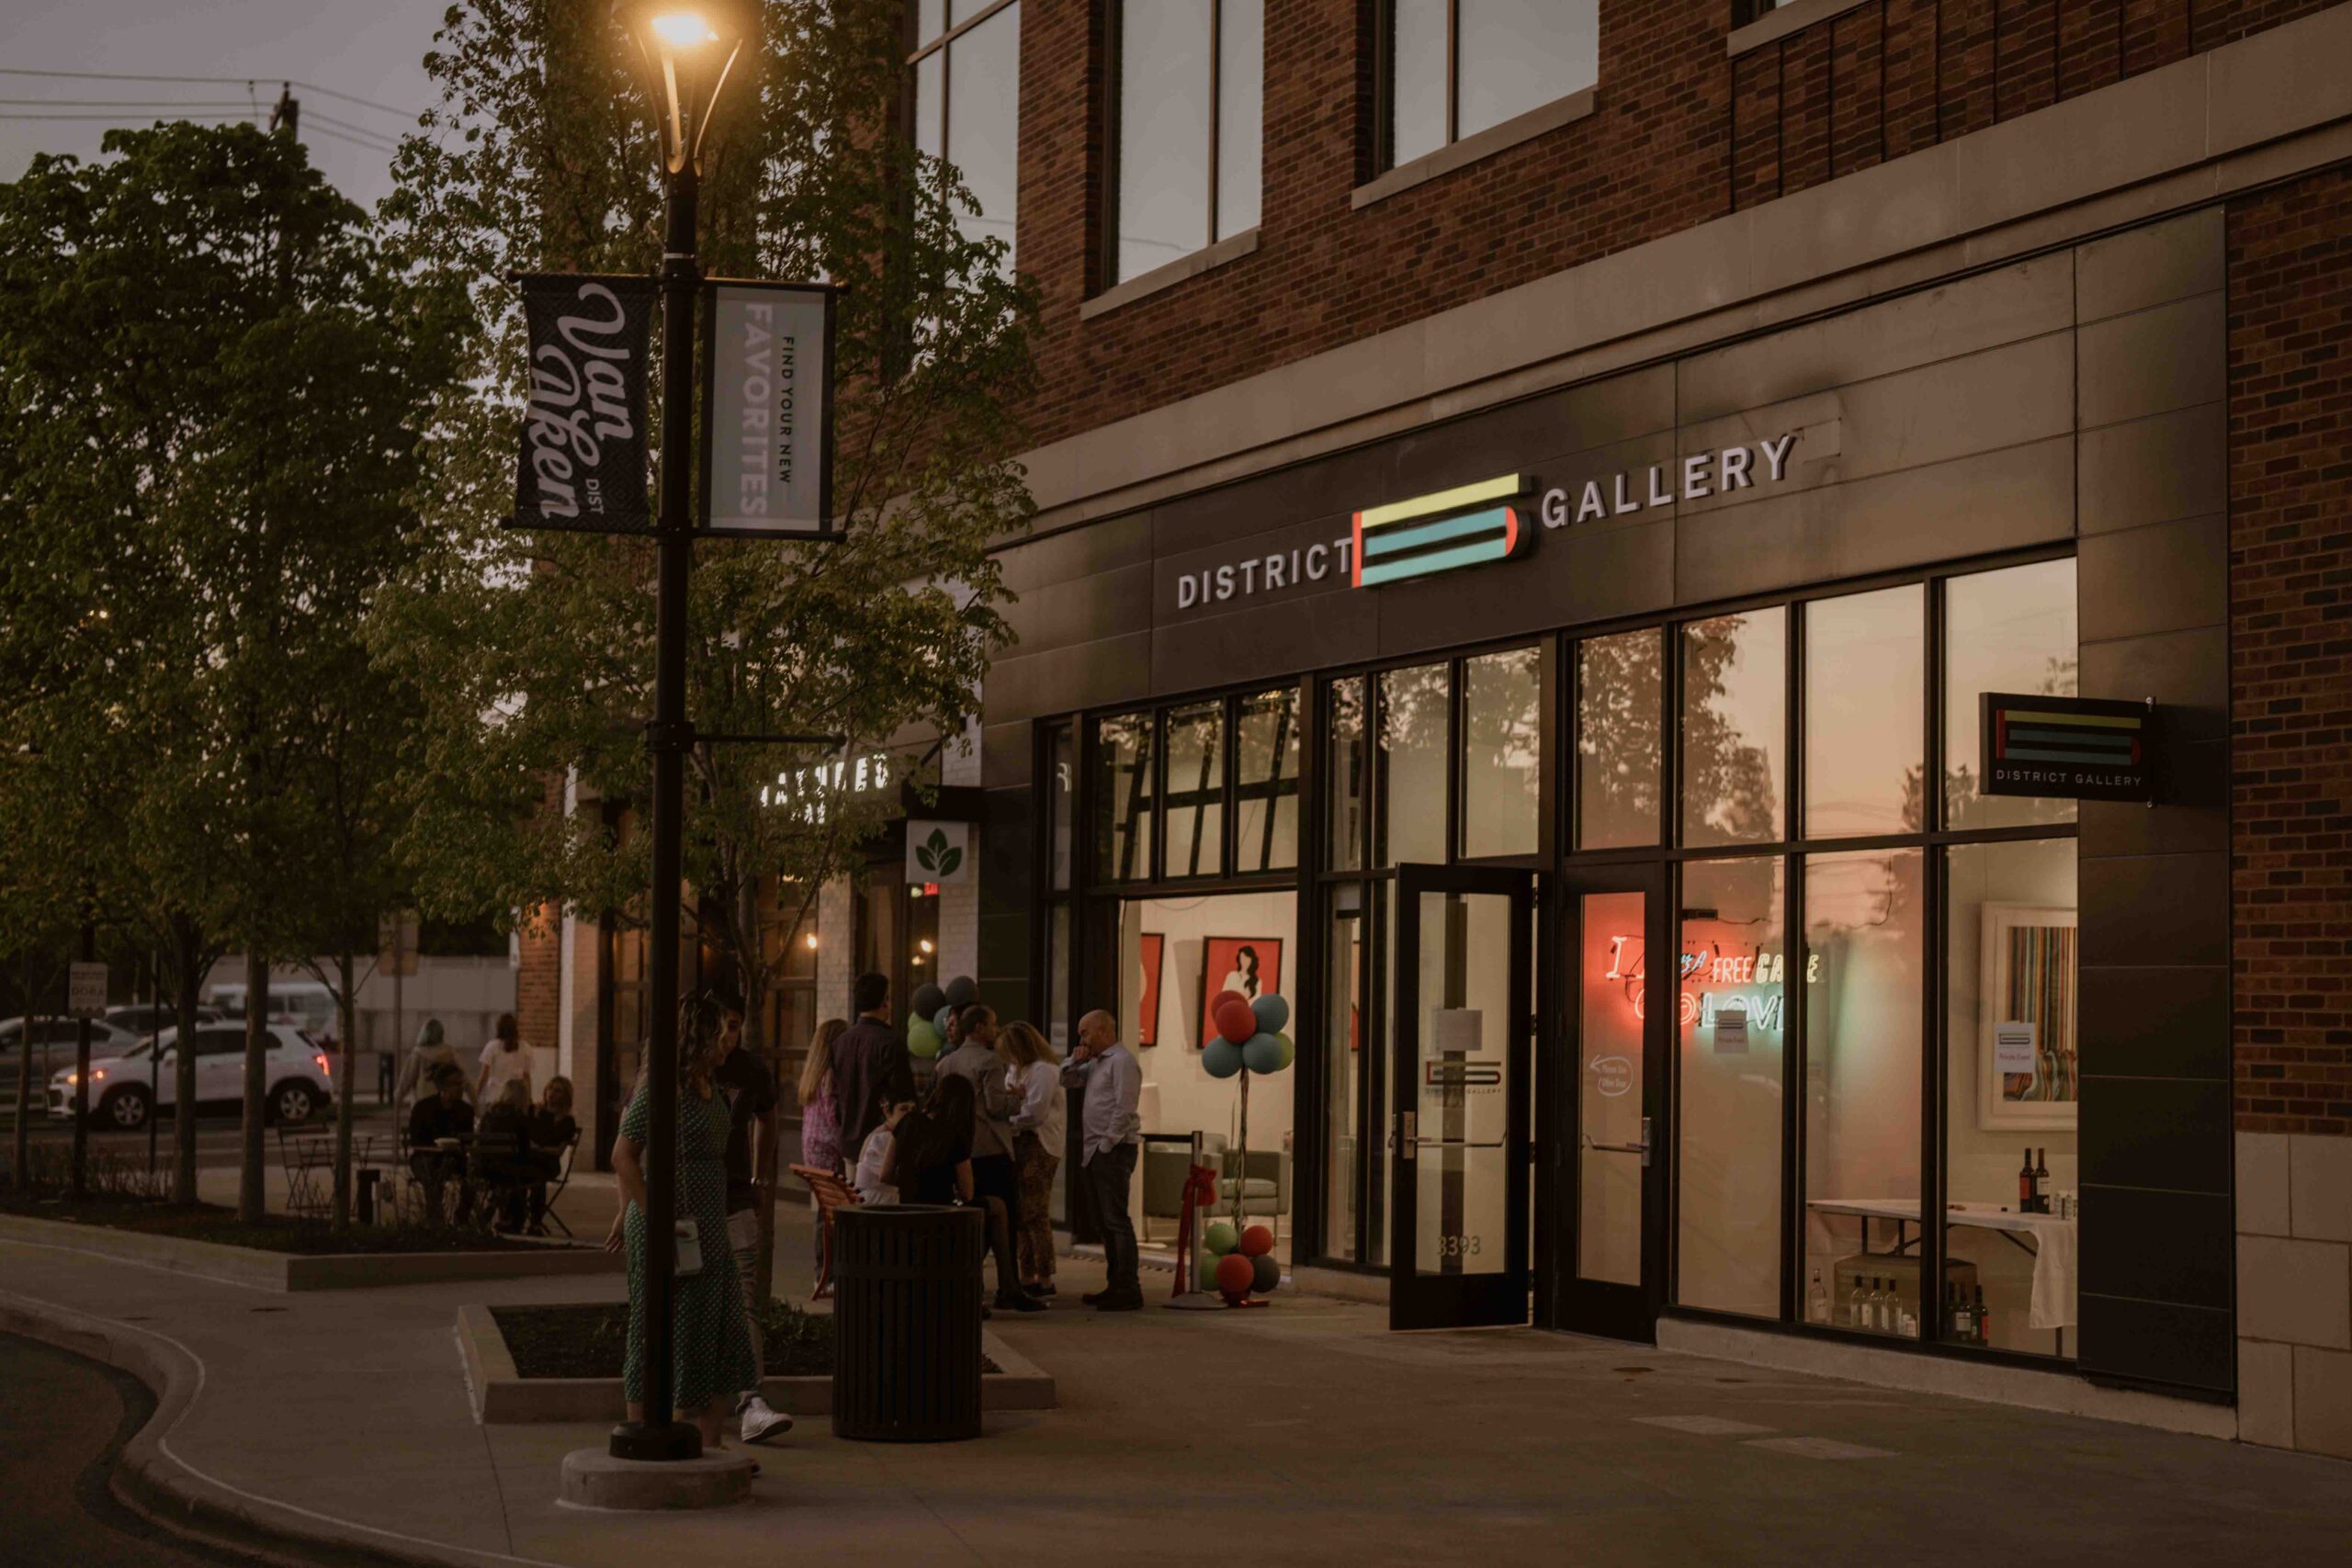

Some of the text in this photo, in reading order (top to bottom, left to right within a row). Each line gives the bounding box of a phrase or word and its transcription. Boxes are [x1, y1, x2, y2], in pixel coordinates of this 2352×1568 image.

[526, 343, 600, 520] Aken
[557, 282, 634, 442] Van
[739, 304, 773, 516] FAVORITES
[779, 336, 795, 484] FIND YOUR NEW
[585, 479, 605, 515] DIST
[1178, 434, 1790, 609] DISTRICT GALLERY
[1996, 769, 2143, 786] DISTRICT GALLERY
[1712, 955, 1753, 984] FREE
[1755, 953, 1820, 985] GAE
[1436, 1235, 1481, 1257] 3393
